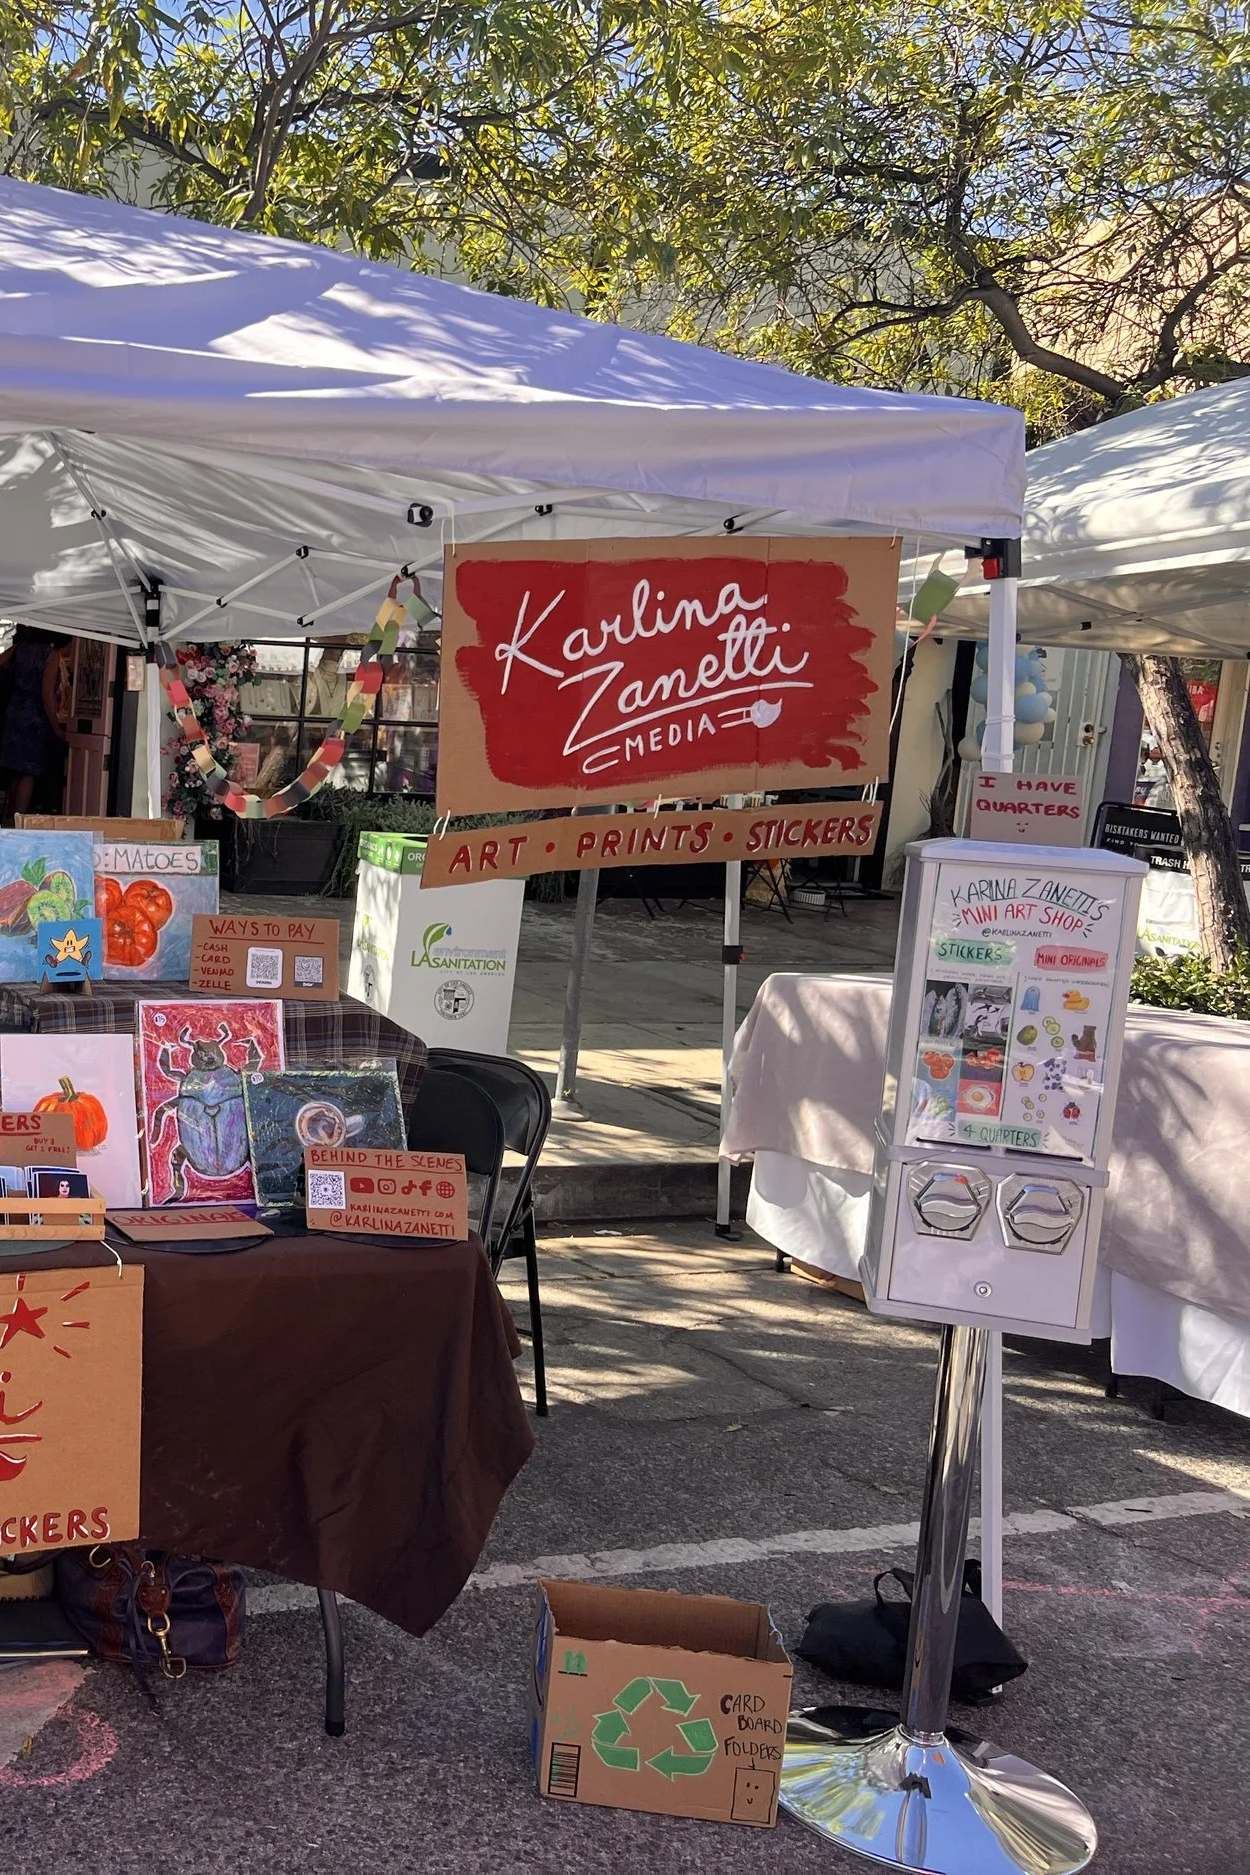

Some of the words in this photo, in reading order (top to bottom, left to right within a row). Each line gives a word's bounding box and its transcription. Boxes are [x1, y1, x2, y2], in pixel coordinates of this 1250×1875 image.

[495, 578, 768, 695] Karlina
[558, 614, 814, 756] Zanetti
[625, 713, 717, 762] MEDIA
[978, 776, 997, 788] I
[1016, 780, 1077, 795] HAVE
[976, 799, 1080, 819] QUARTERS
[449, 836, 528, 873] ART
[576, 821, 715, 858] PRINTS
[746, 814, 874, 852] STICKERS
[1150, 830, 1180, 844] WANTED
[1150, 855, 1181, 869] TRASH
[962, 904, 998, 925] MINI
[1004, 903, 1038, 921] ART
[1039, 906, 1084, 933] SHOP
[209, 919, 259, 936] WAYS
[263, 923, 280, 936] TO
[288, 923, 315, 940] PAY
[937, 942, 1004, 961] STICKERS
[1036, 952, 1056, 966] MINI
[1060, 953, 1107, 968] ORIGINALS
[33, 1137, 48, 1145] BUY
[962, 1124, 976, 1139] 4
[980, 1126, 1039, 1149] QUARTERS
[311, 1149, 367, 1165] BEHIND
[374, 1154, 403, 1168] THE
[411, 1155, 463, 1171] SCENES
[330, 1210, 455, 1236] @KARLINAZANETTI
[720, 1694, 765, 1714] CARD
[737, 1714, 783, 1735] BOARD
[724, 1736, 782, 1760] FOLDERS
